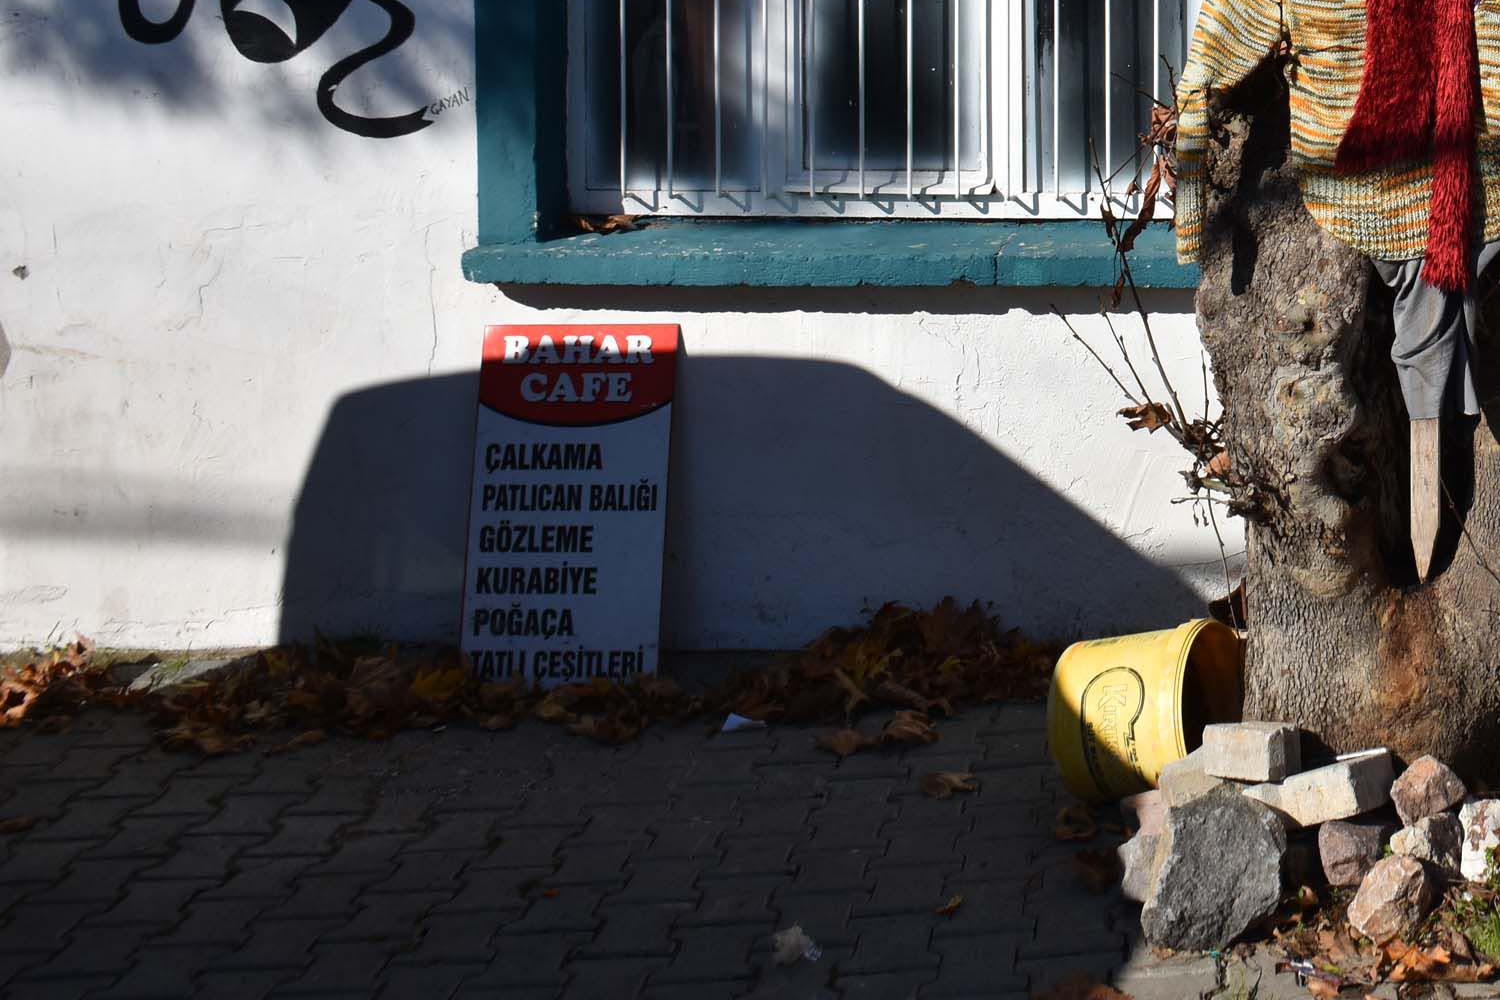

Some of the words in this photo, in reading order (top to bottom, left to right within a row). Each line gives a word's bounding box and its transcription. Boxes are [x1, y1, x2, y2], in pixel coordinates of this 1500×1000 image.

[503, 335, 655, 365] BAHAR
[520, 372, 633, 403] CAFE
[485, 443, 603, 473] ÇALKAMA
[481, 484, 583, 512] PATLICAN
[588, 478, 657, 512] BALIĞI
[479, 520, 594, 553] GÖZLEME
[475, 561, 598, 596] KURABİYE
[473, 604, 575, 640] POĞAÇA
[532, 645, 644, 682] ÇEŞİTLERİ
